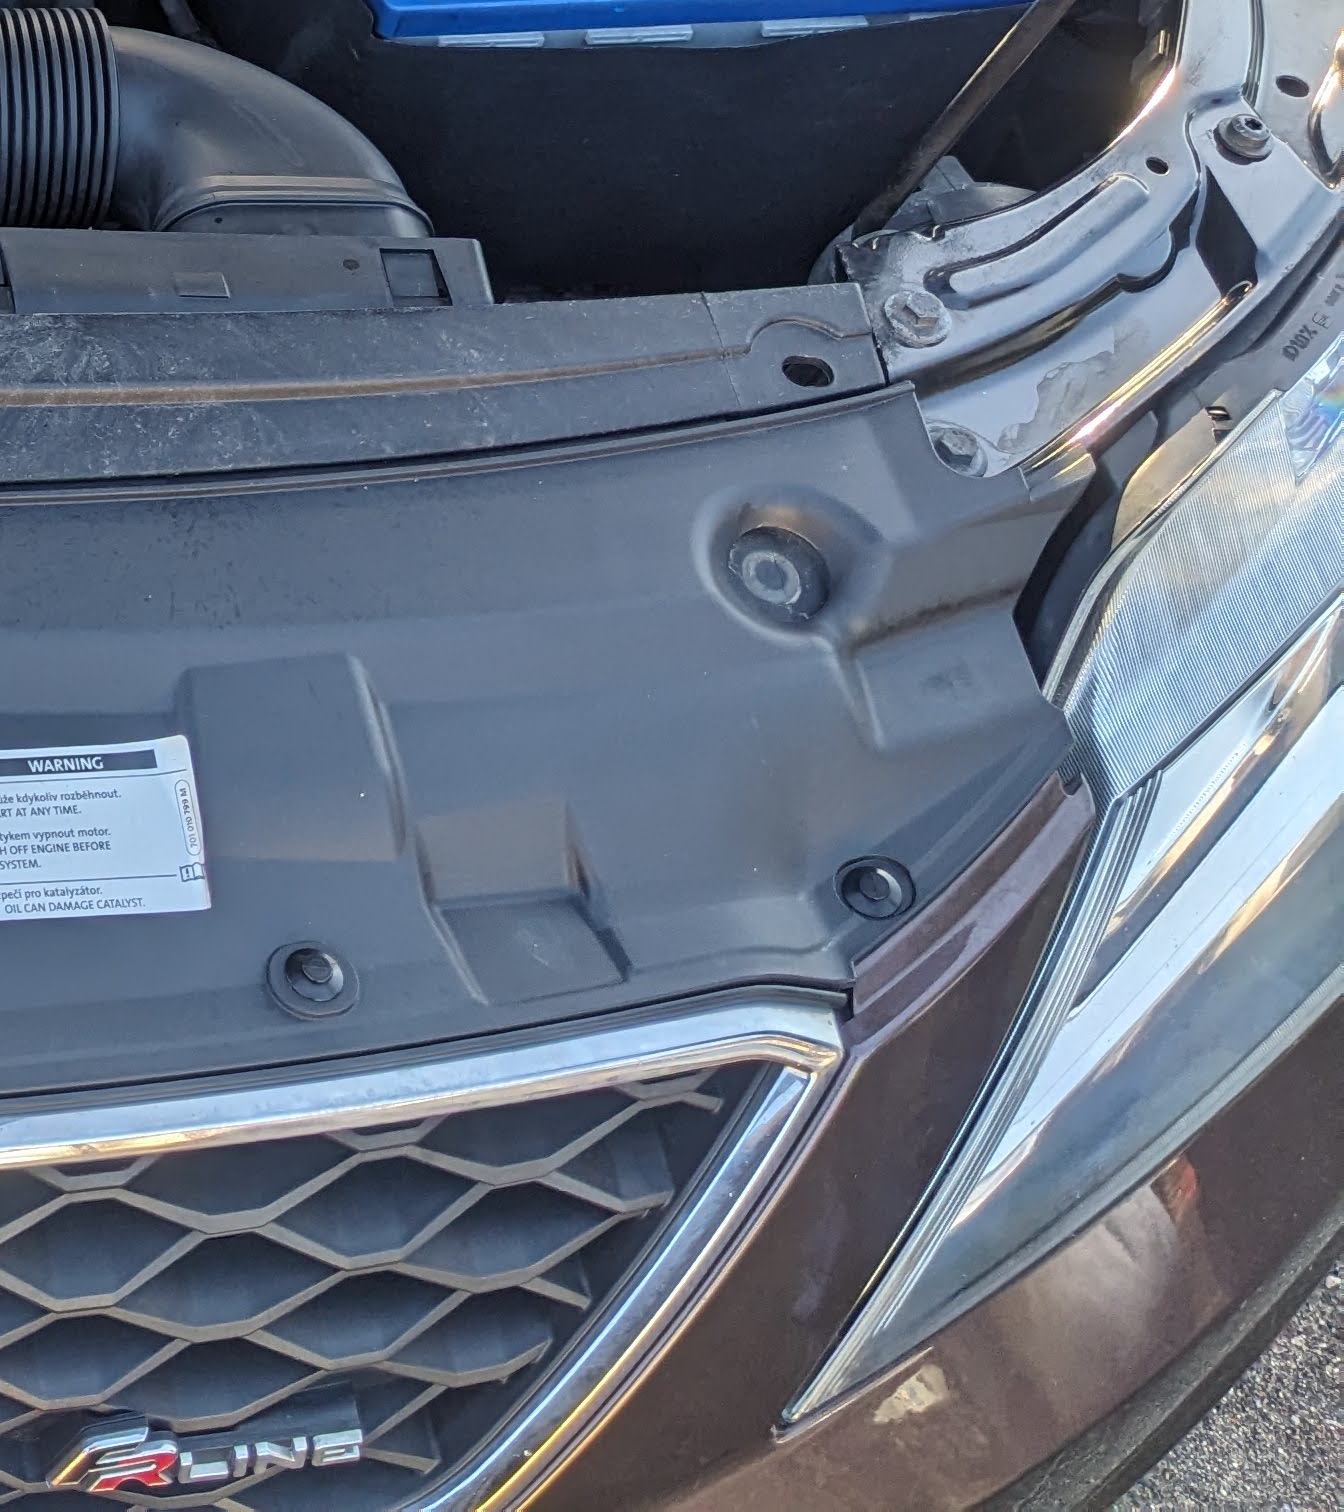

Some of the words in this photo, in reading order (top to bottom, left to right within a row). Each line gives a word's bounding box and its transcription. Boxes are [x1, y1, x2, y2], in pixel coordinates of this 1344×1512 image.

[26, 756, 104, 773] WARNING
[15, 791, 58, 805] kdykoliv
[59, 788, 121, 802] rozběhnout.
[14, 807, 27, 817] AT
[29, 806, 51, 816] ANY
[52, 804, 81, 815] TIME.
[32, 828, 75, 842] vypnout
[77, 826, 112, 837] motor.
[8, 844, 29, 855] OFF
[30, 842, 70, 854] ENGINE
[72, 840, 111, 852] BEFORE
[24, 890, 41, 903] pro
[42, 886, 103, 901] katalyzátor.
[4, 904, 22, 914] OIL
[23, 902, 46, 913] CAN
[47, 900, 94, 911] DAMAGE
[95, 897, 145, 909] CATALYST.
